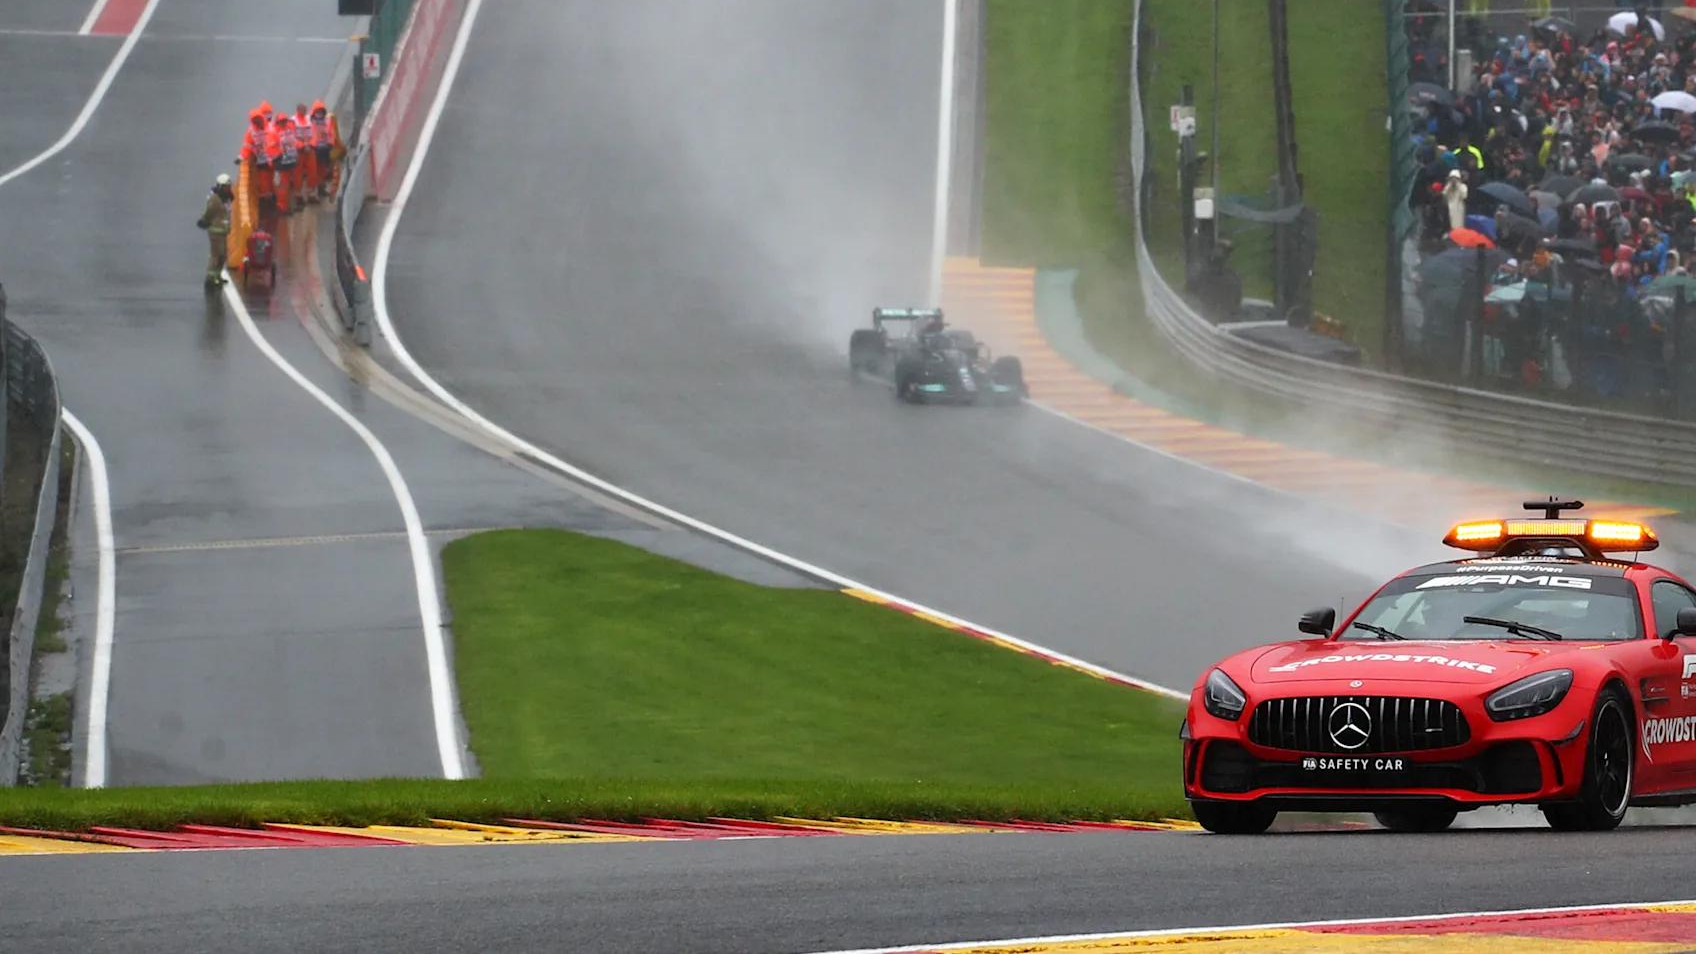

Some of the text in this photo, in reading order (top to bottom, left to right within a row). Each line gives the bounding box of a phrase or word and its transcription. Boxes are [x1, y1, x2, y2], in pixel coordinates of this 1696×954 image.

[1456, 564, 1564, 574] #PurposeDriven
[1281, 653, 1497, 675] CROWDSTRIKE
[1319, 758, 1368, 770] SAFETY
[1375, 759, 1403, 771] CAR
